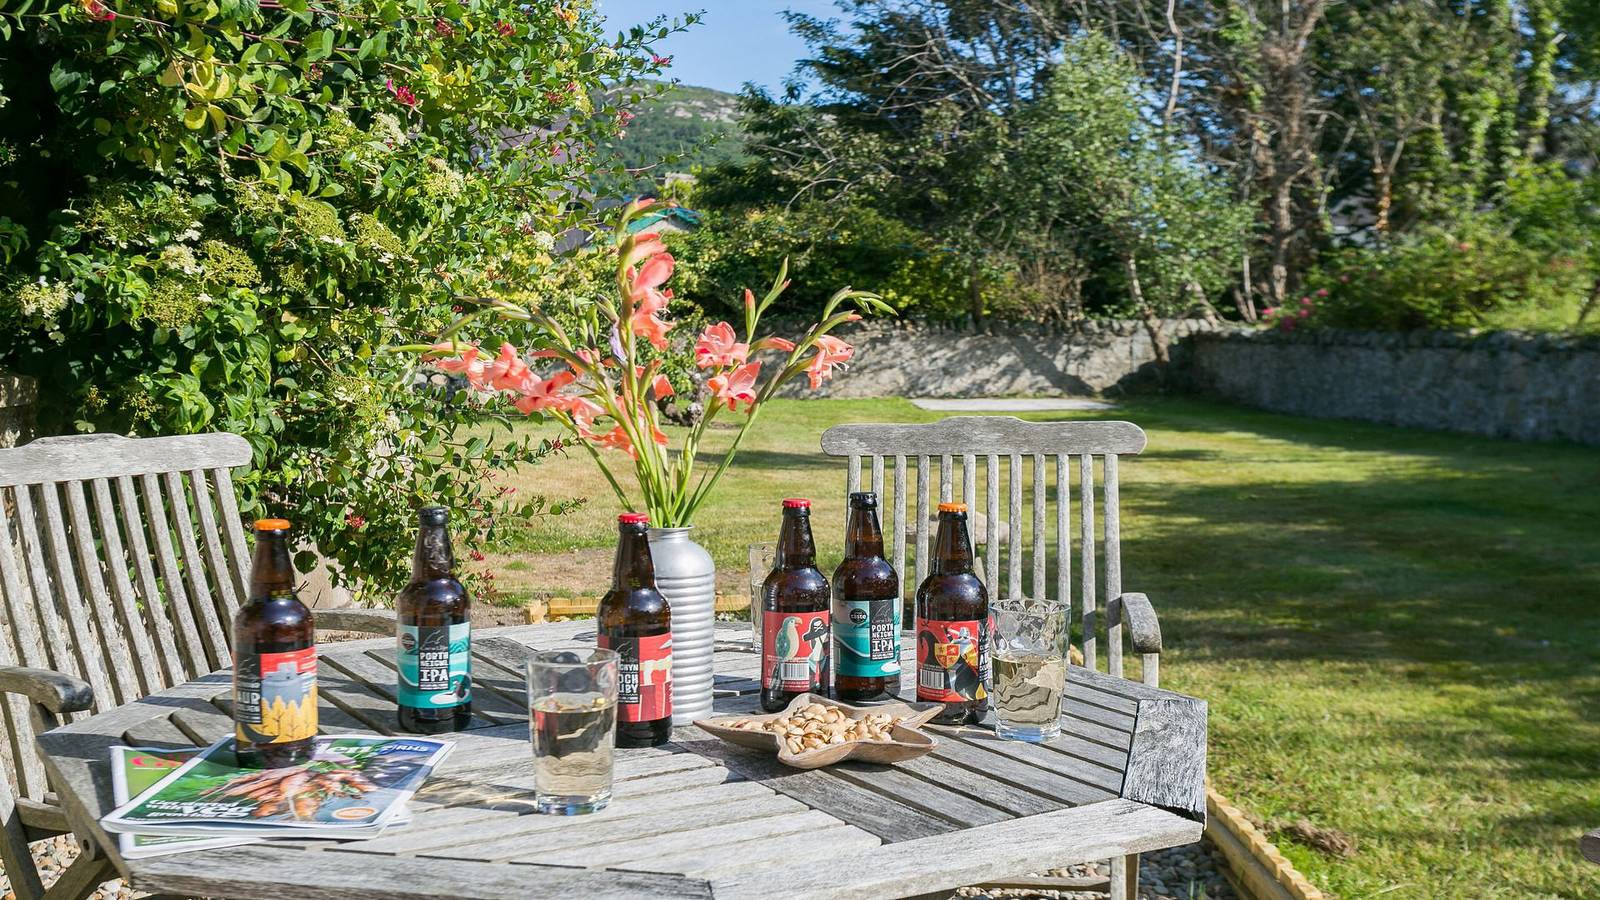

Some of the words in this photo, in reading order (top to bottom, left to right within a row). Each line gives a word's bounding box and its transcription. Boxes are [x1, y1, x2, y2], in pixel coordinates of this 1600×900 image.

[871, 623, 894, 632] PORTH
[420, 652, 449, 660] PORTH
[618, 673, 639, 684] OCH
[617, 683, 639, 694] UBY
